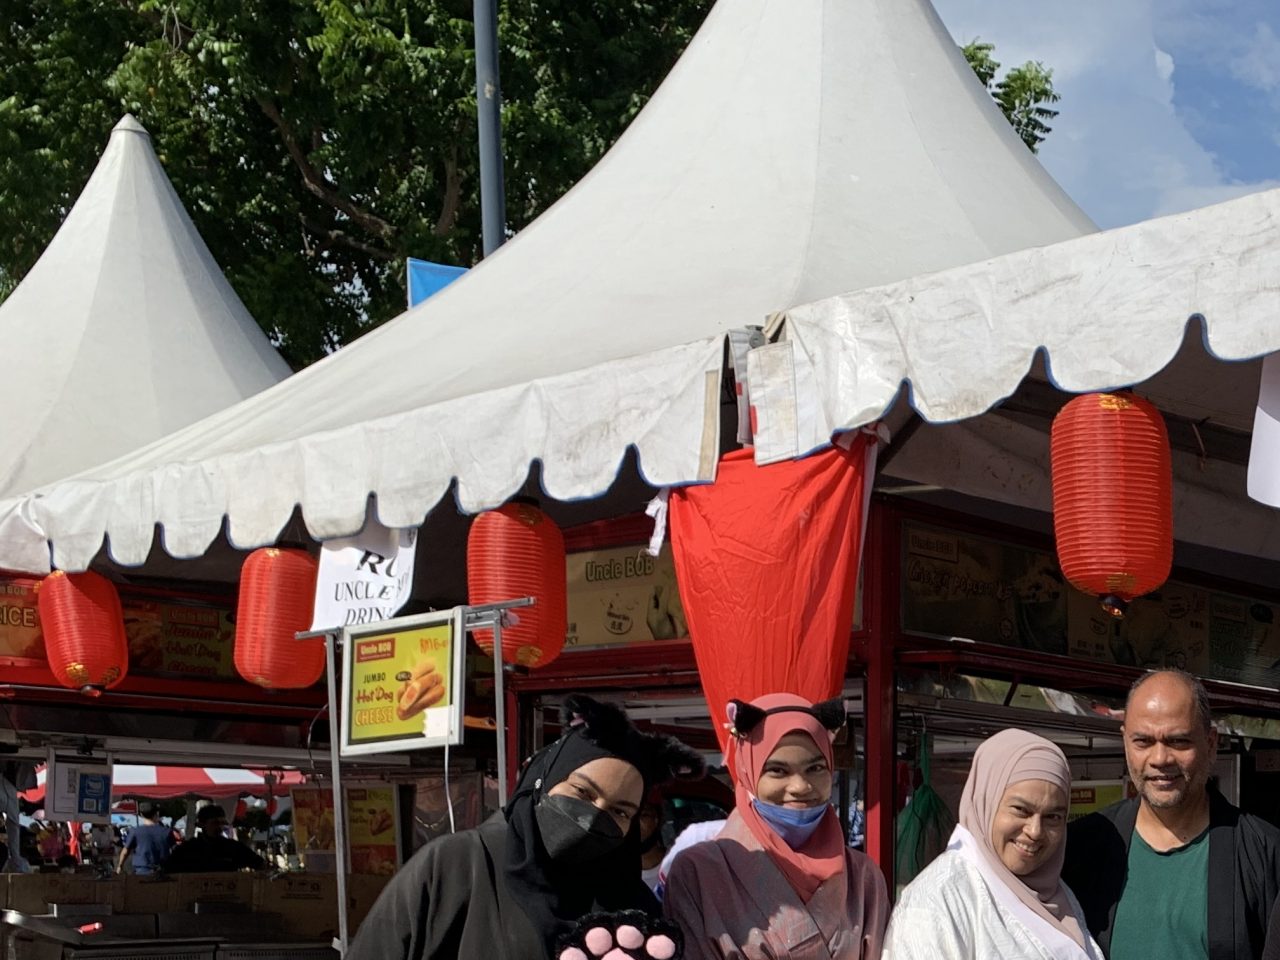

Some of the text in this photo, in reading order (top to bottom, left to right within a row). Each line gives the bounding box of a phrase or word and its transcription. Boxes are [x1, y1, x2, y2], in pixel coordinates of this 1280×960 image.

[585, 555, 655, 583] Uncle BOB
[334, 579, 395, 602] UNCLE
[363, 672, 386, 683] JUMBO
[375, 686, 394, 703] Dog
[355, 706, 394, 726] CHEESE
